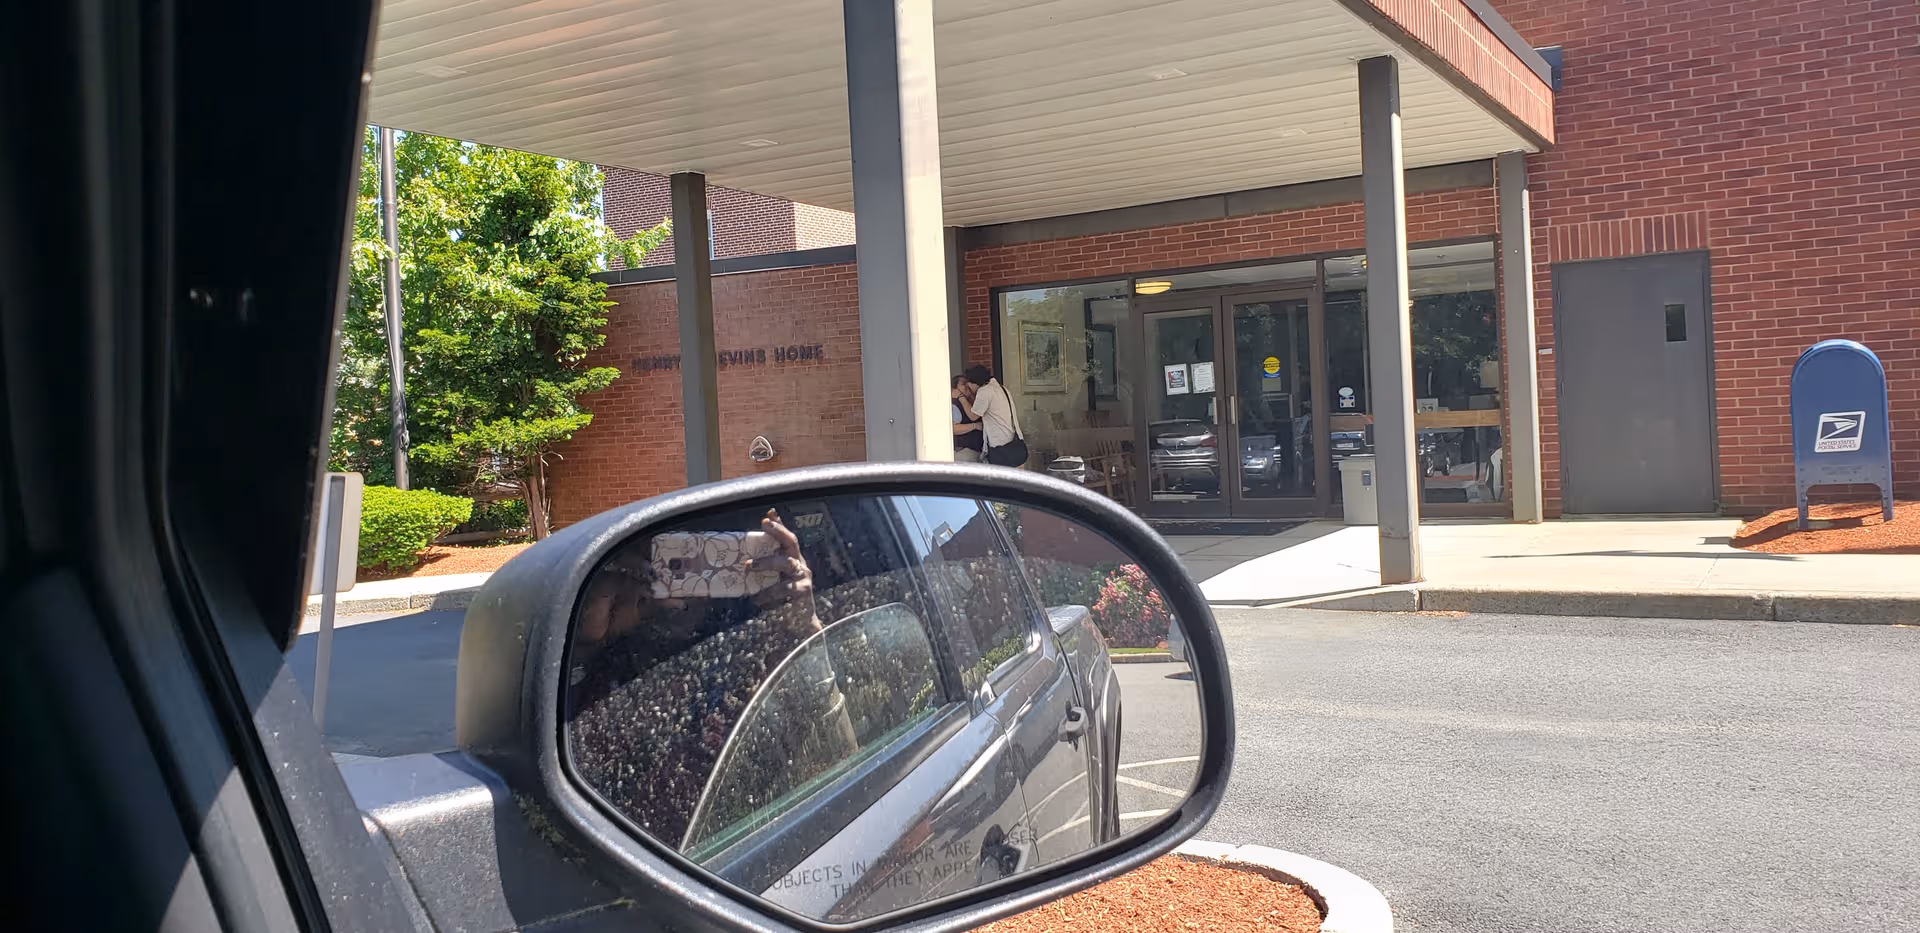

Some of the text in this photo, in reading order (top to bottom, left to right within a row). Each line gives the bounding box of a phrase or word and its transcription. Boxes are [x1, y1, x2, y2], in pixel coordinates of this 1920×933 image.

[720, 349, 766, 366] EVINS
[774, 345, 823, 363] HOME
[773, 864, 842, 890] OBJECTS
[852, 859, 867, 876] IN
[877, 847, 935, 869] MROR
[945, 840, 973, 859] ARE
[830, 858, 981, 899] TH THEY APPE
